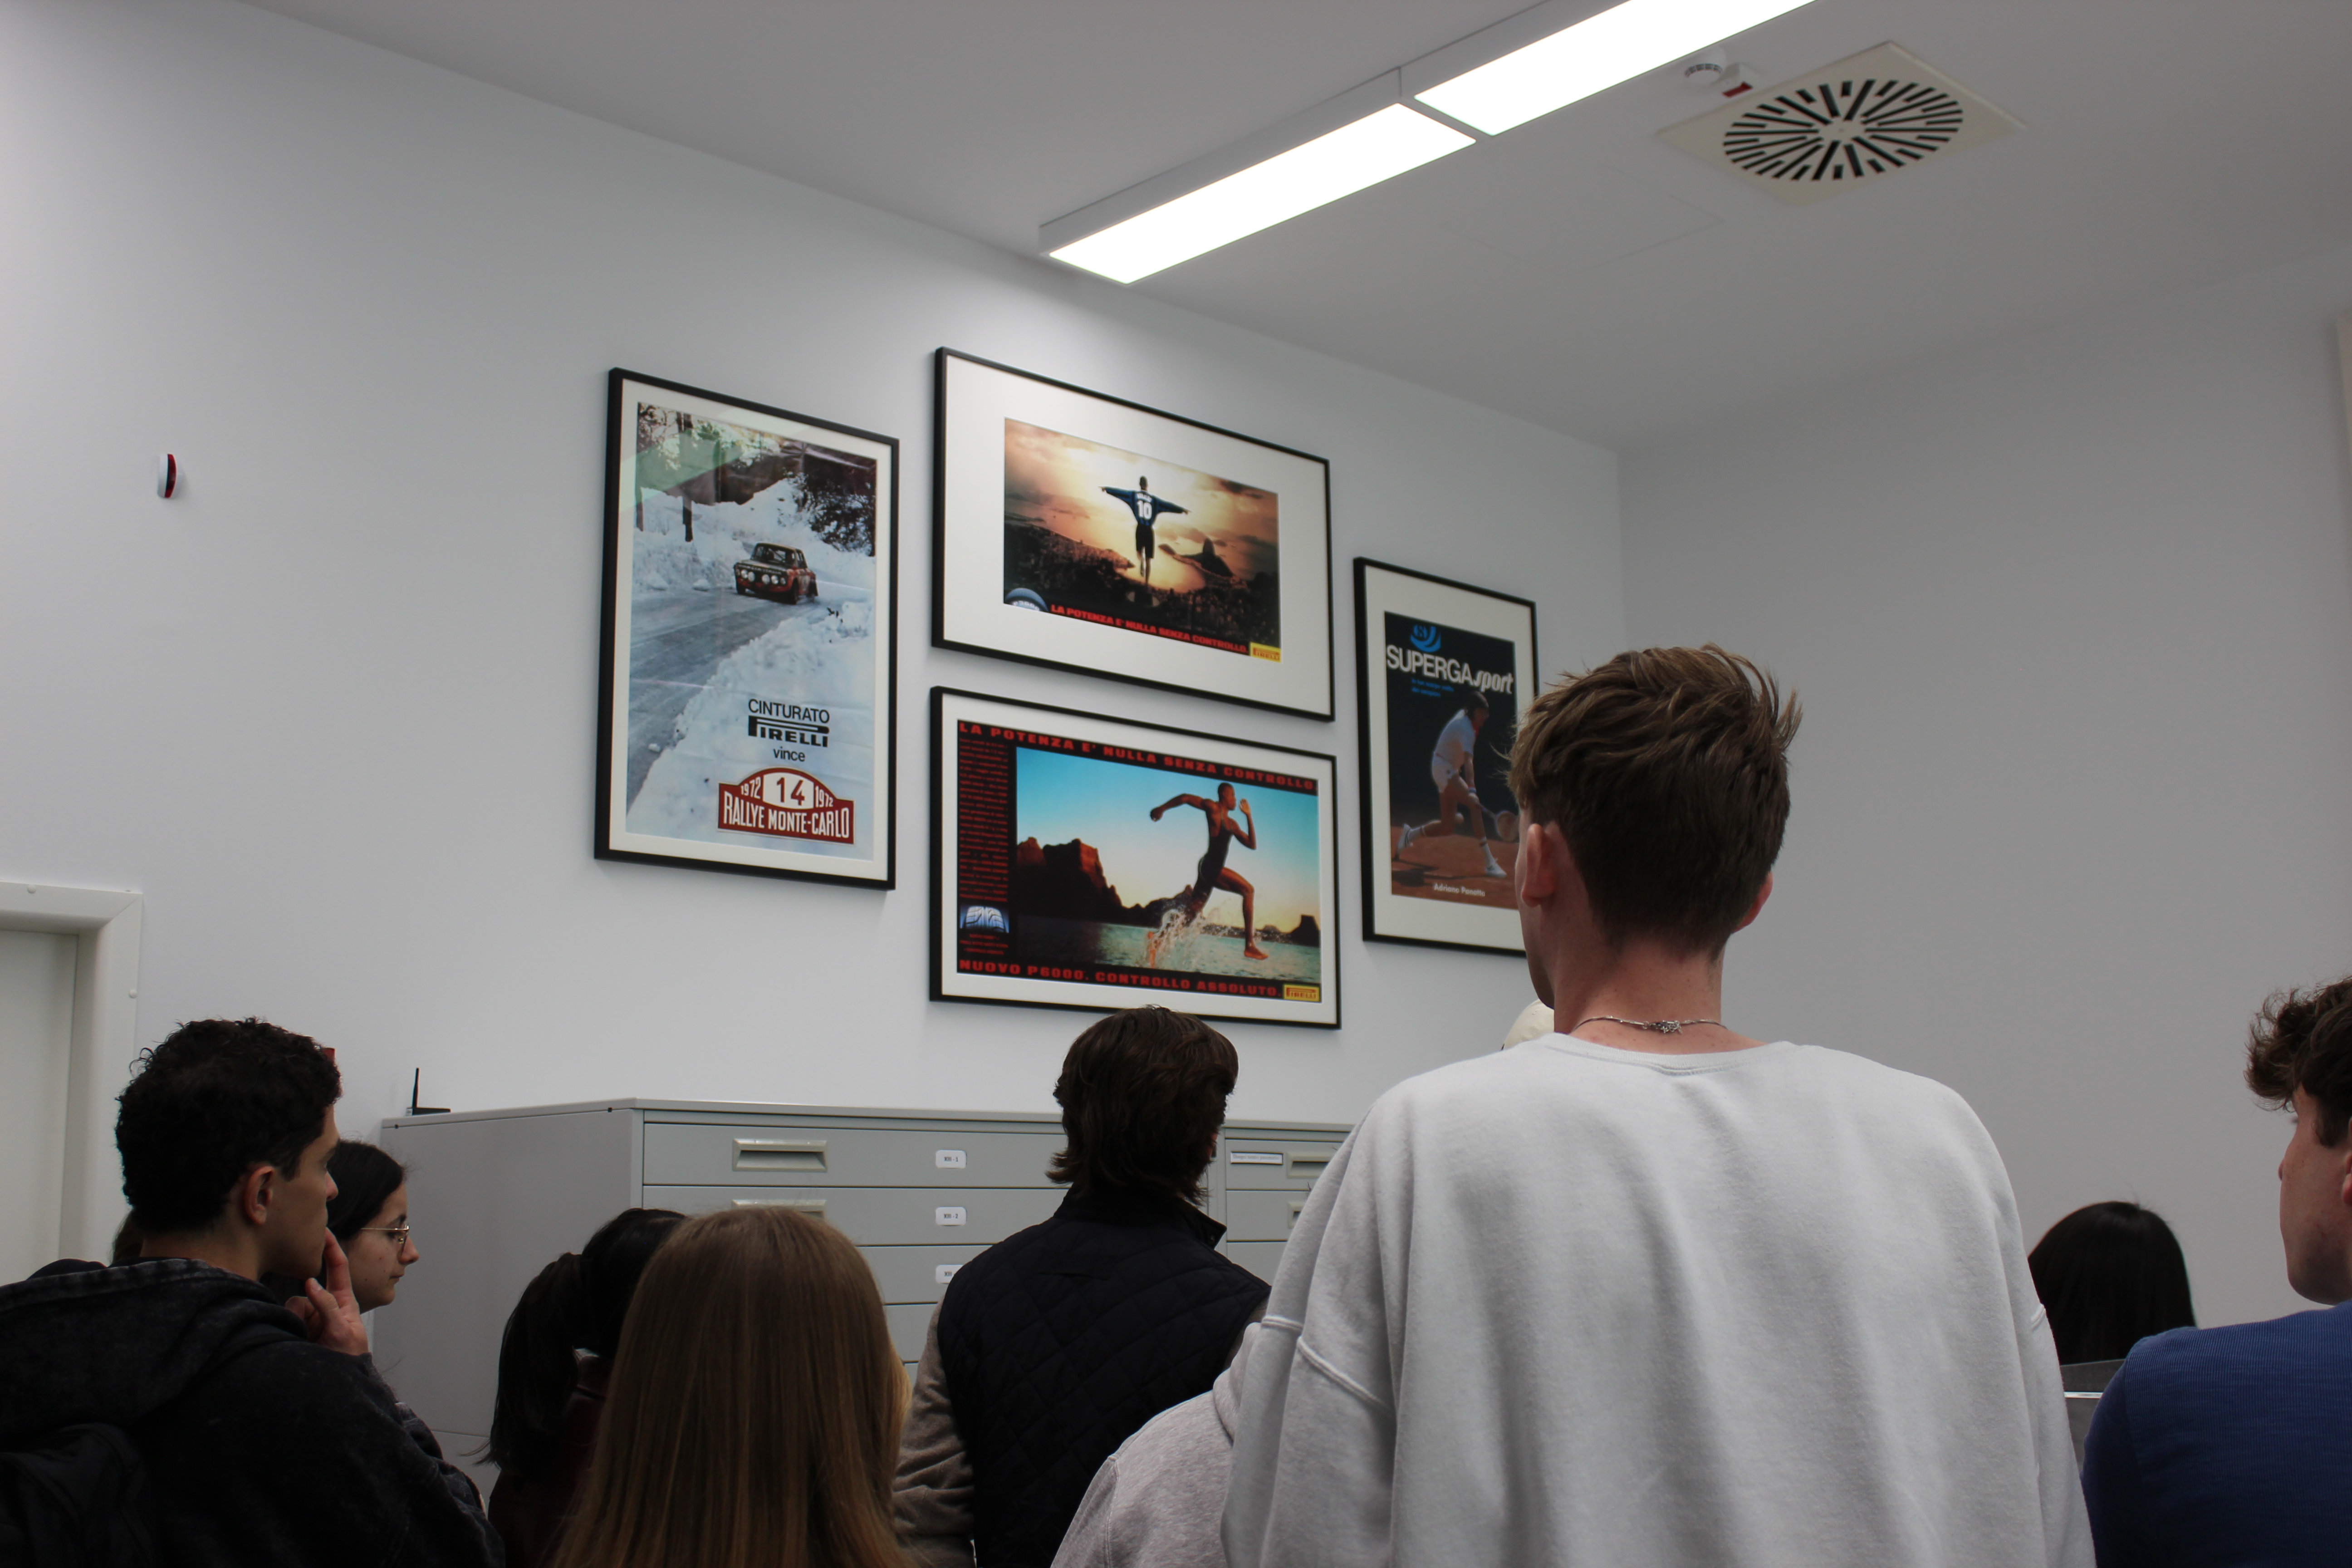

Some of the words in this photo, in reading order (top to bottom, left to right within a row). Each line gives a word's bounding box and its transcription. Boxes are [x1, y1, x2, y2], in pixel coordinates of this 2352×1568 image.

[1137, 500, 1152, 519] 10
[1050, 604, 1066, 614] LA
[1066, 607, 1114, 625] POTENZA
[1125, 620, 1157, 634] NULLA
[1159, 627, 1191, 641] SENZA
[1253, 647, 1280, 661] PIRELLI
[748, 698, 830, 724] CINTURATO
[748, 715, 830, 748] PIRELLI
[773, 746, 806, 762] vince
[959, 722, 982, 735] LA
[990, 727, 1074, 750] POTENZA
[1103, 746, 1156, 764] NULLA
[1164, 756, 1216, 774] SENZA
[740, 776, 761, 800] 1972
[777, 777, 806, 806] 14
[815, 785, 834, 808] 1972
[723, 790, 765, 828] RALLYE
[768, 807, 850, 839] MONTE-CARLO
[1433, 882, 1460, 894] Adriano
[959, 959, 1021, 975] NUOVO
[1095, 971, 1191, 990] CONTROLLO
[1286, 987, 1317, 999] PIRELLI
